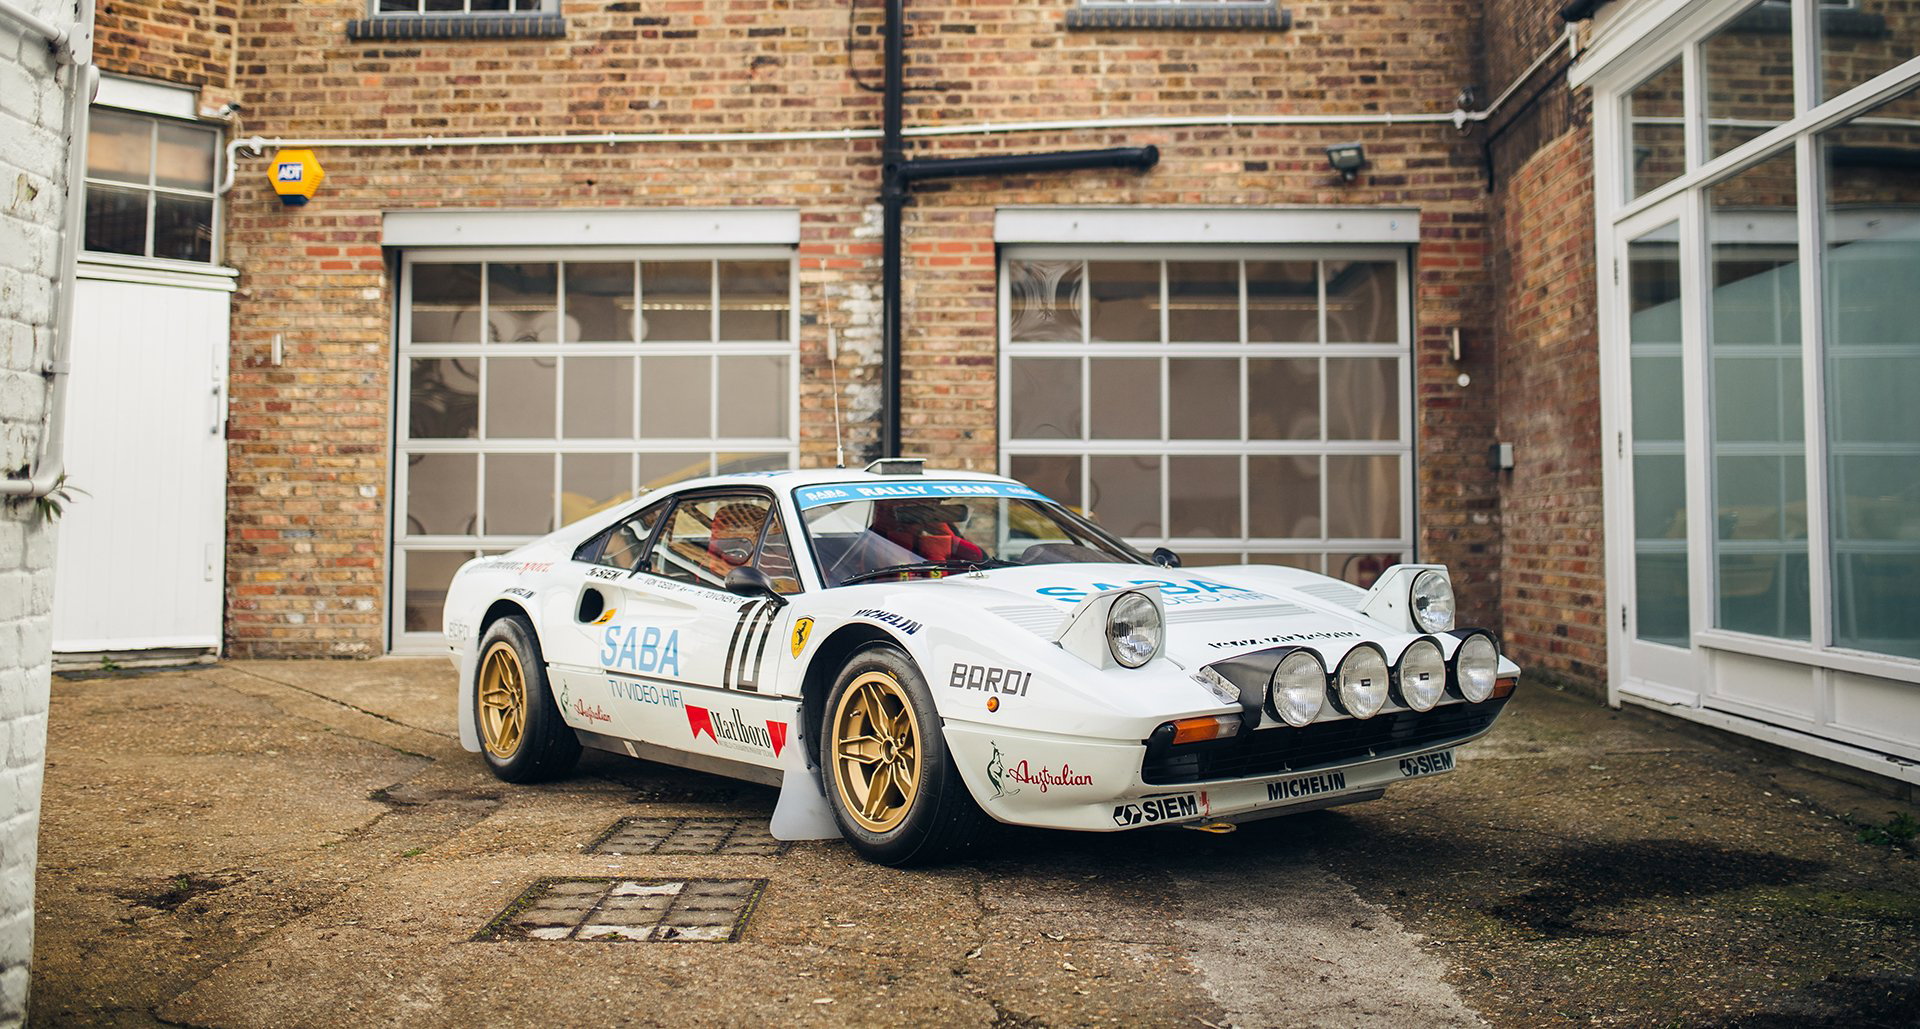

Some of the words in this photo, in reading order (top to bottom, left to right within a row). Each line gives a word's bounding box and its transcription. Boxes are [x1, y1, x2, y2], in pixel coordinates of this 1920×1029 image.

[278, 164, 302, 180] ADT
[855, 486, 928, 497] RALLY
[932, 485, 999, 495] TEAM
[852, 609, 923, 635] MICHELIN
[601, 625, 679, 677] SABA
[723, 599, 783, 692] 10
[949, 663, 1032, 697] BARDI
[710, 707, 771, 749] Marlboro
[1008, 759, 1093, 793] Australian
[1420, 750, 1454, 774] SIEM
[1267, 772, 1346, 800] MICHELIN
[1144, 795, 1198, 821] SIEM
